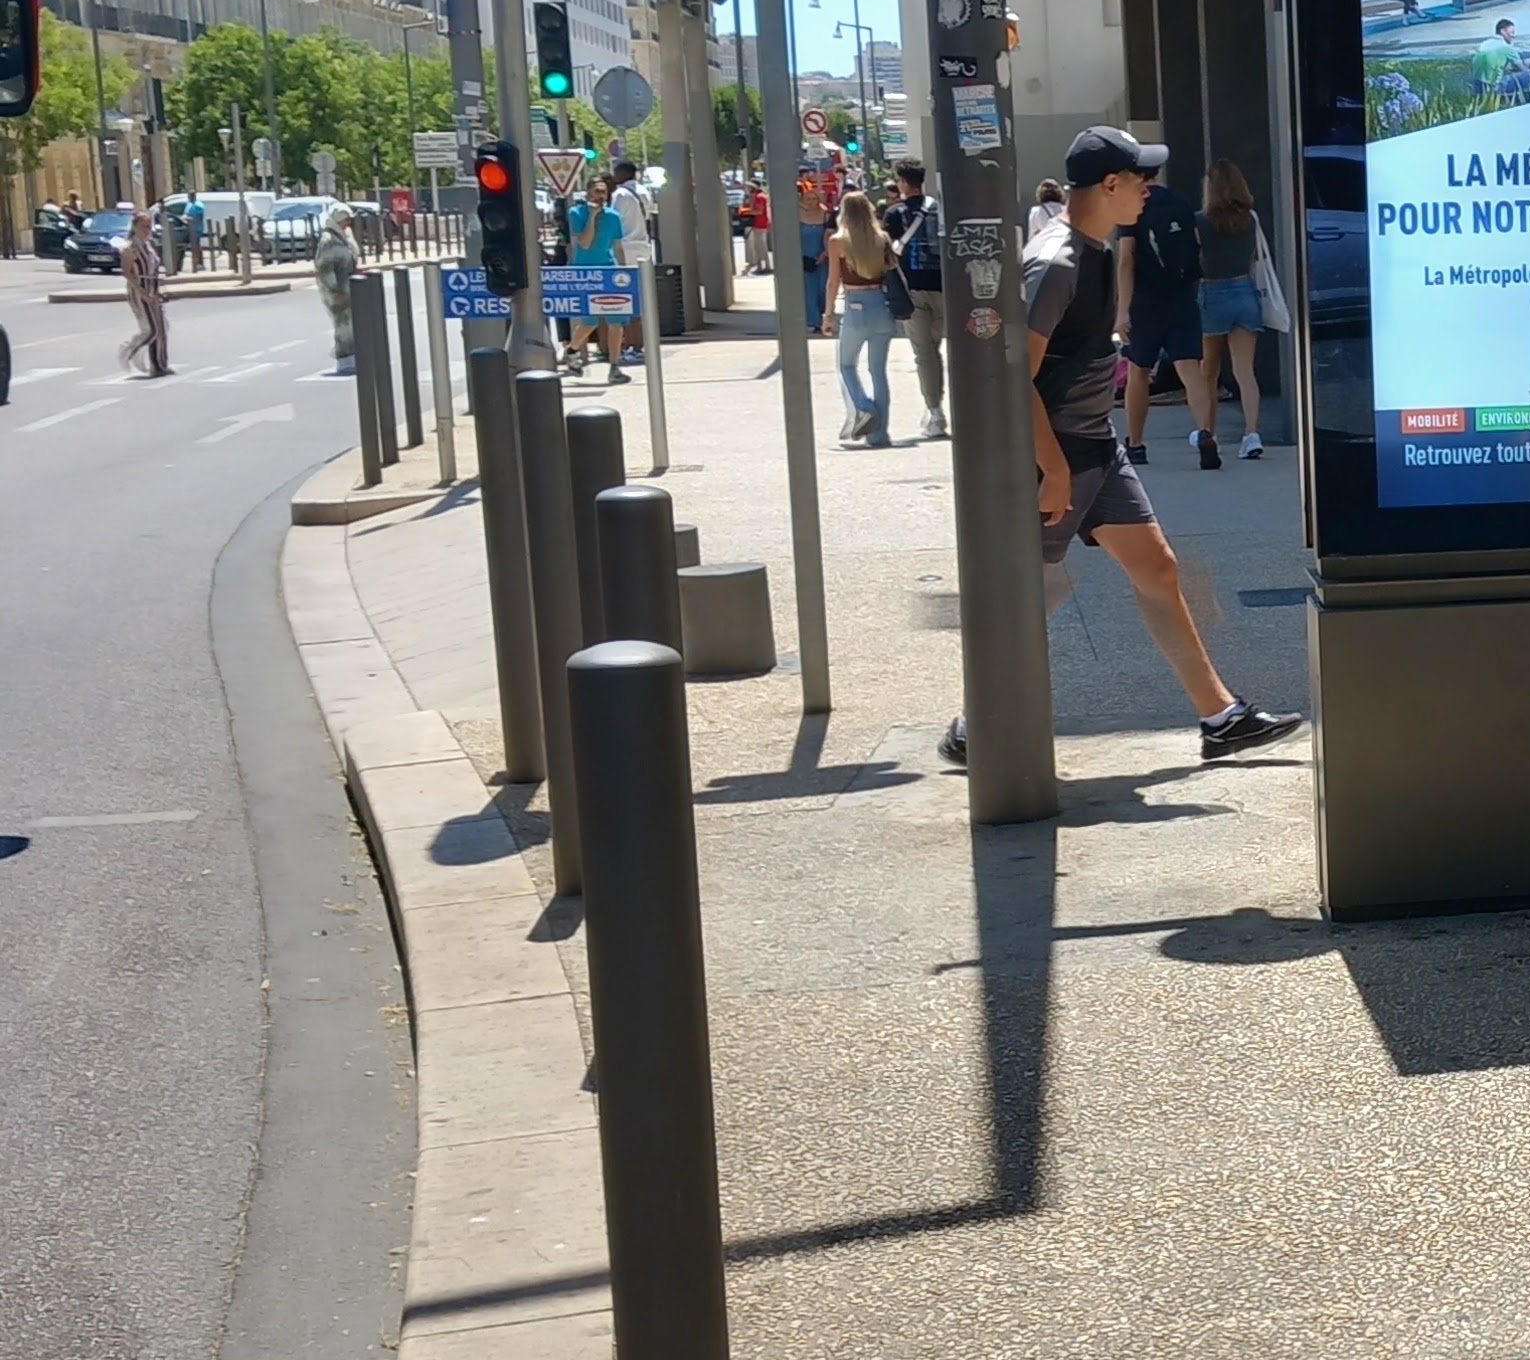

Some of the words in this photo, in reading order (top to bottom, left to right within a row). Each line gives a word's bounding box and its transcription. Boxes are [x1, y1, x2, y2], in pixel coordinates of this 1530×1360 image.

[1447, 152, 1486, 187] LA
[1378, 200, 1462, 236] POUR
[1424, 266, 1445, 286] La
[1407, 413, 1459, 428] MOBILITÉ
[1404, 444, 1491, 466] Retrouvez
